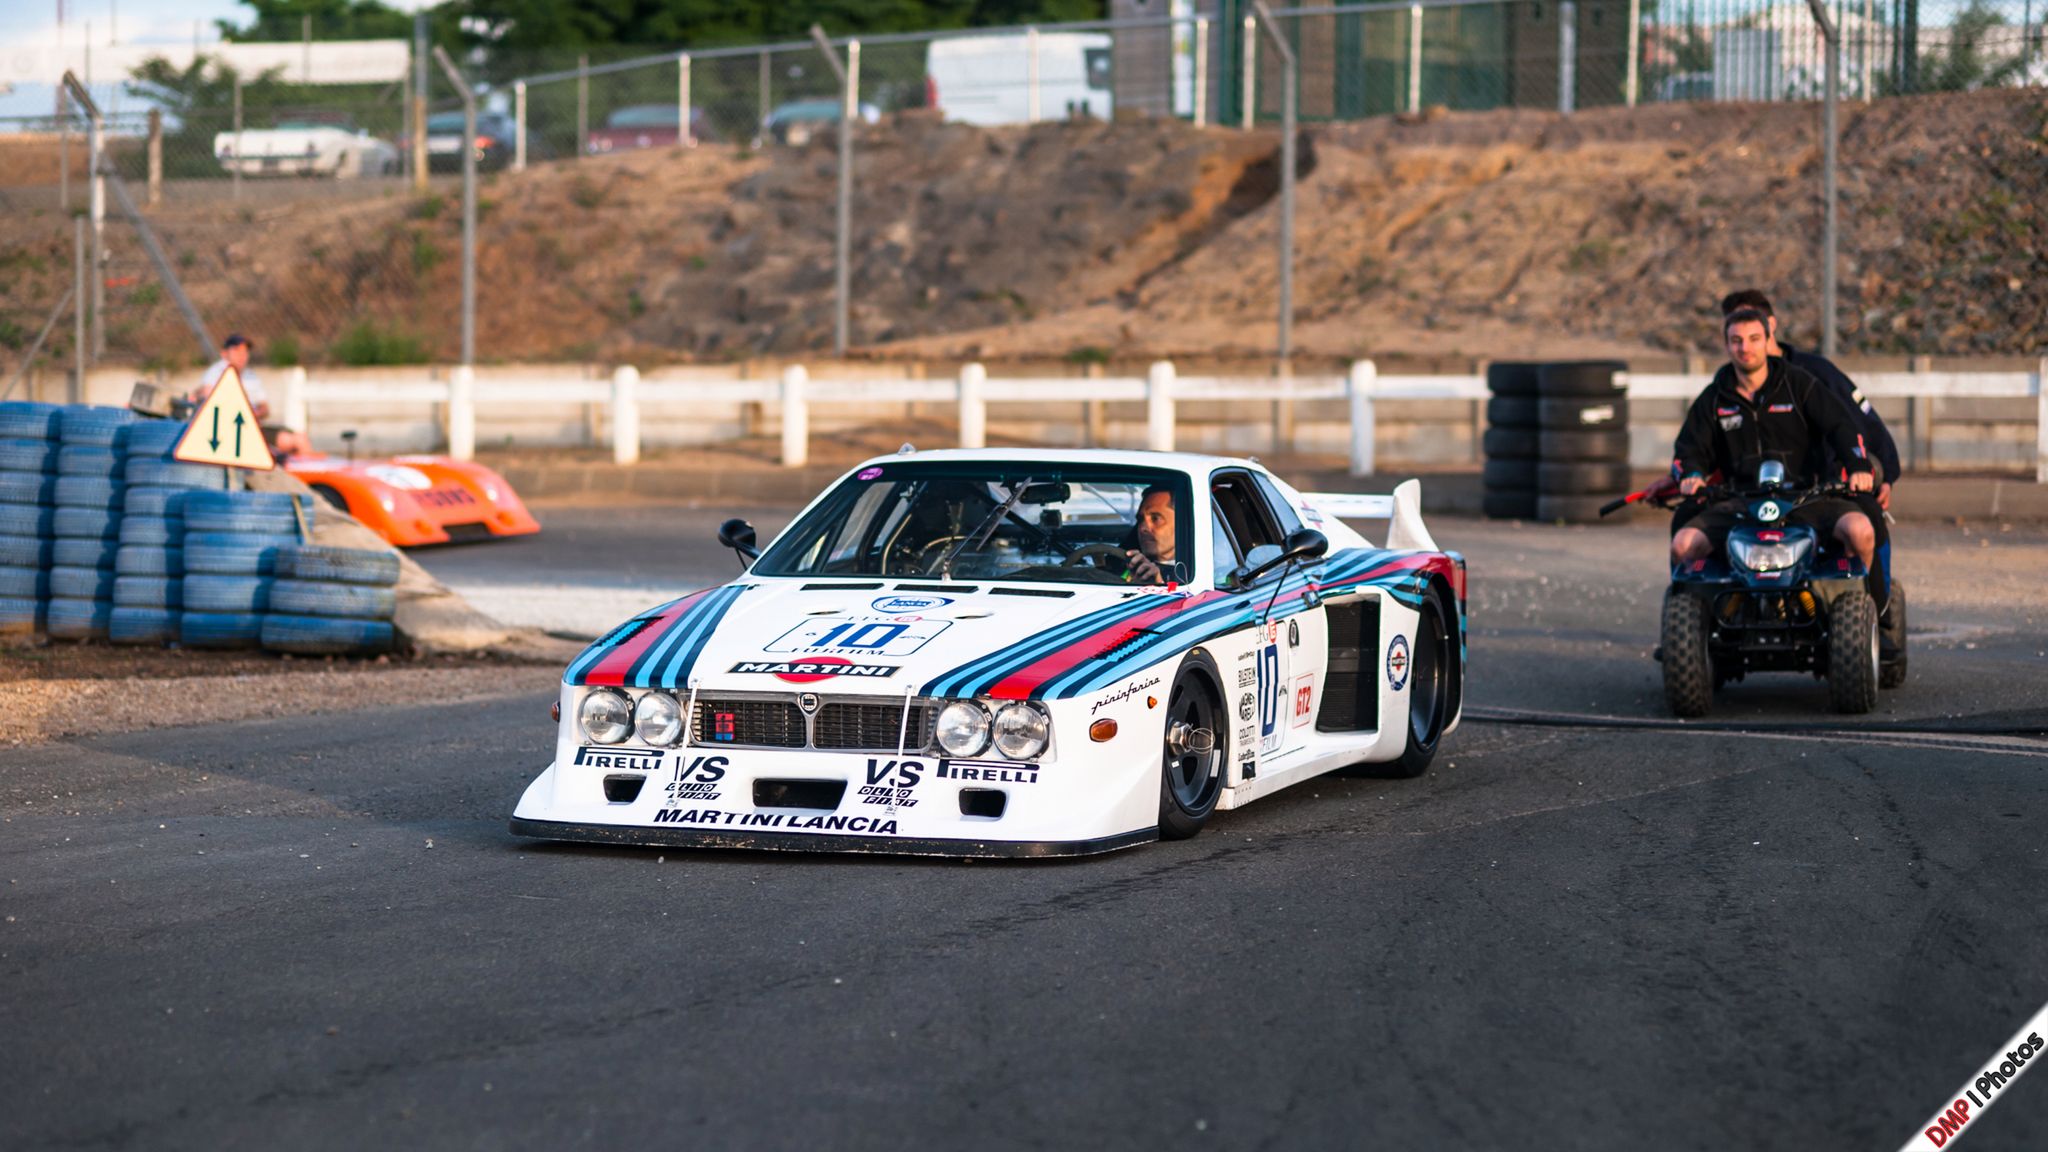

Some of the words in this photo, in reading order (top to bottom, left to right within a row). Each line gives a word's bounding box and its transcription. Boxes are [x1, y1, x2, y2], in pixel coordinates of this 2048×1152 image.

[810, 623, 911, 648] 10
[738, 663, 890, 677] MARTINI
[1091, 677, 1160, 715] pininfarina
[1296, 686, 1312, 717] GT2
[573, 746, 665, 770] PIRELLI
[674, 756, 729, 783] VS
[936, 759, 1040, 783] PIRELLI
[866, 759, 924, 788] VS
[653, 809, 786, 827] MARTINI
[786, 815, 898, 835] LANCIA
